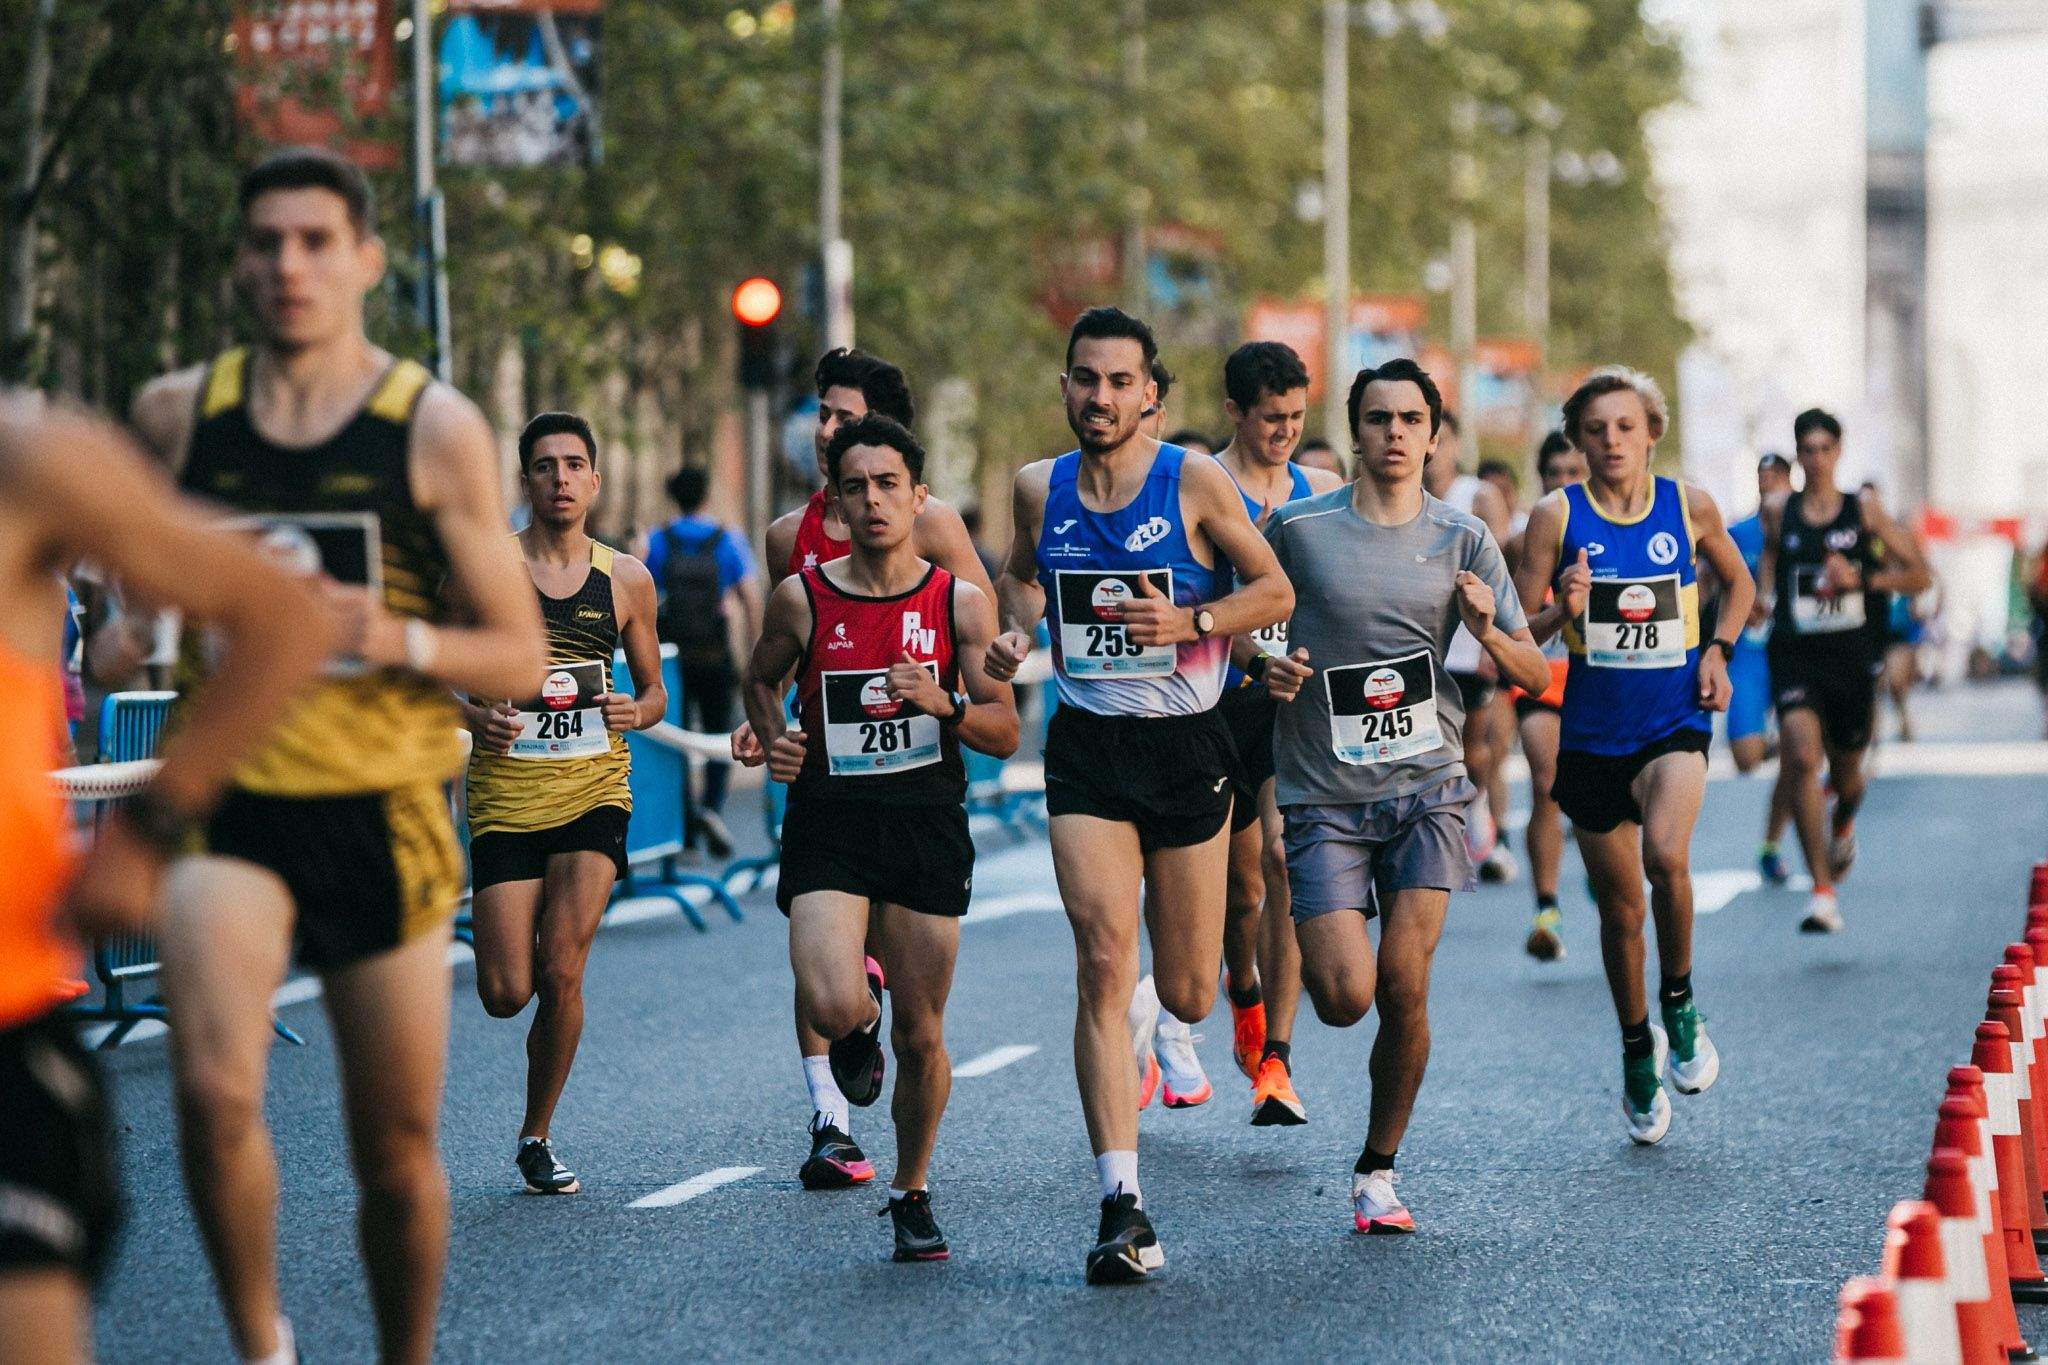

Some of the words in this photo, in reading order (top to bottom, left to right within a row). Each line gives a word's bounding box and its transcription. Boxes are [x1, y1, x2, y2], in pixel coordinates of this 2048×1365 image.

[1086, 625, 1144, 657] 259
[1615, 624, 1660, 650] 278
[537, 711, 583, 739] 264
[859, 719, 912, 754] 281
[1361, 708, 1413, 744] 245
